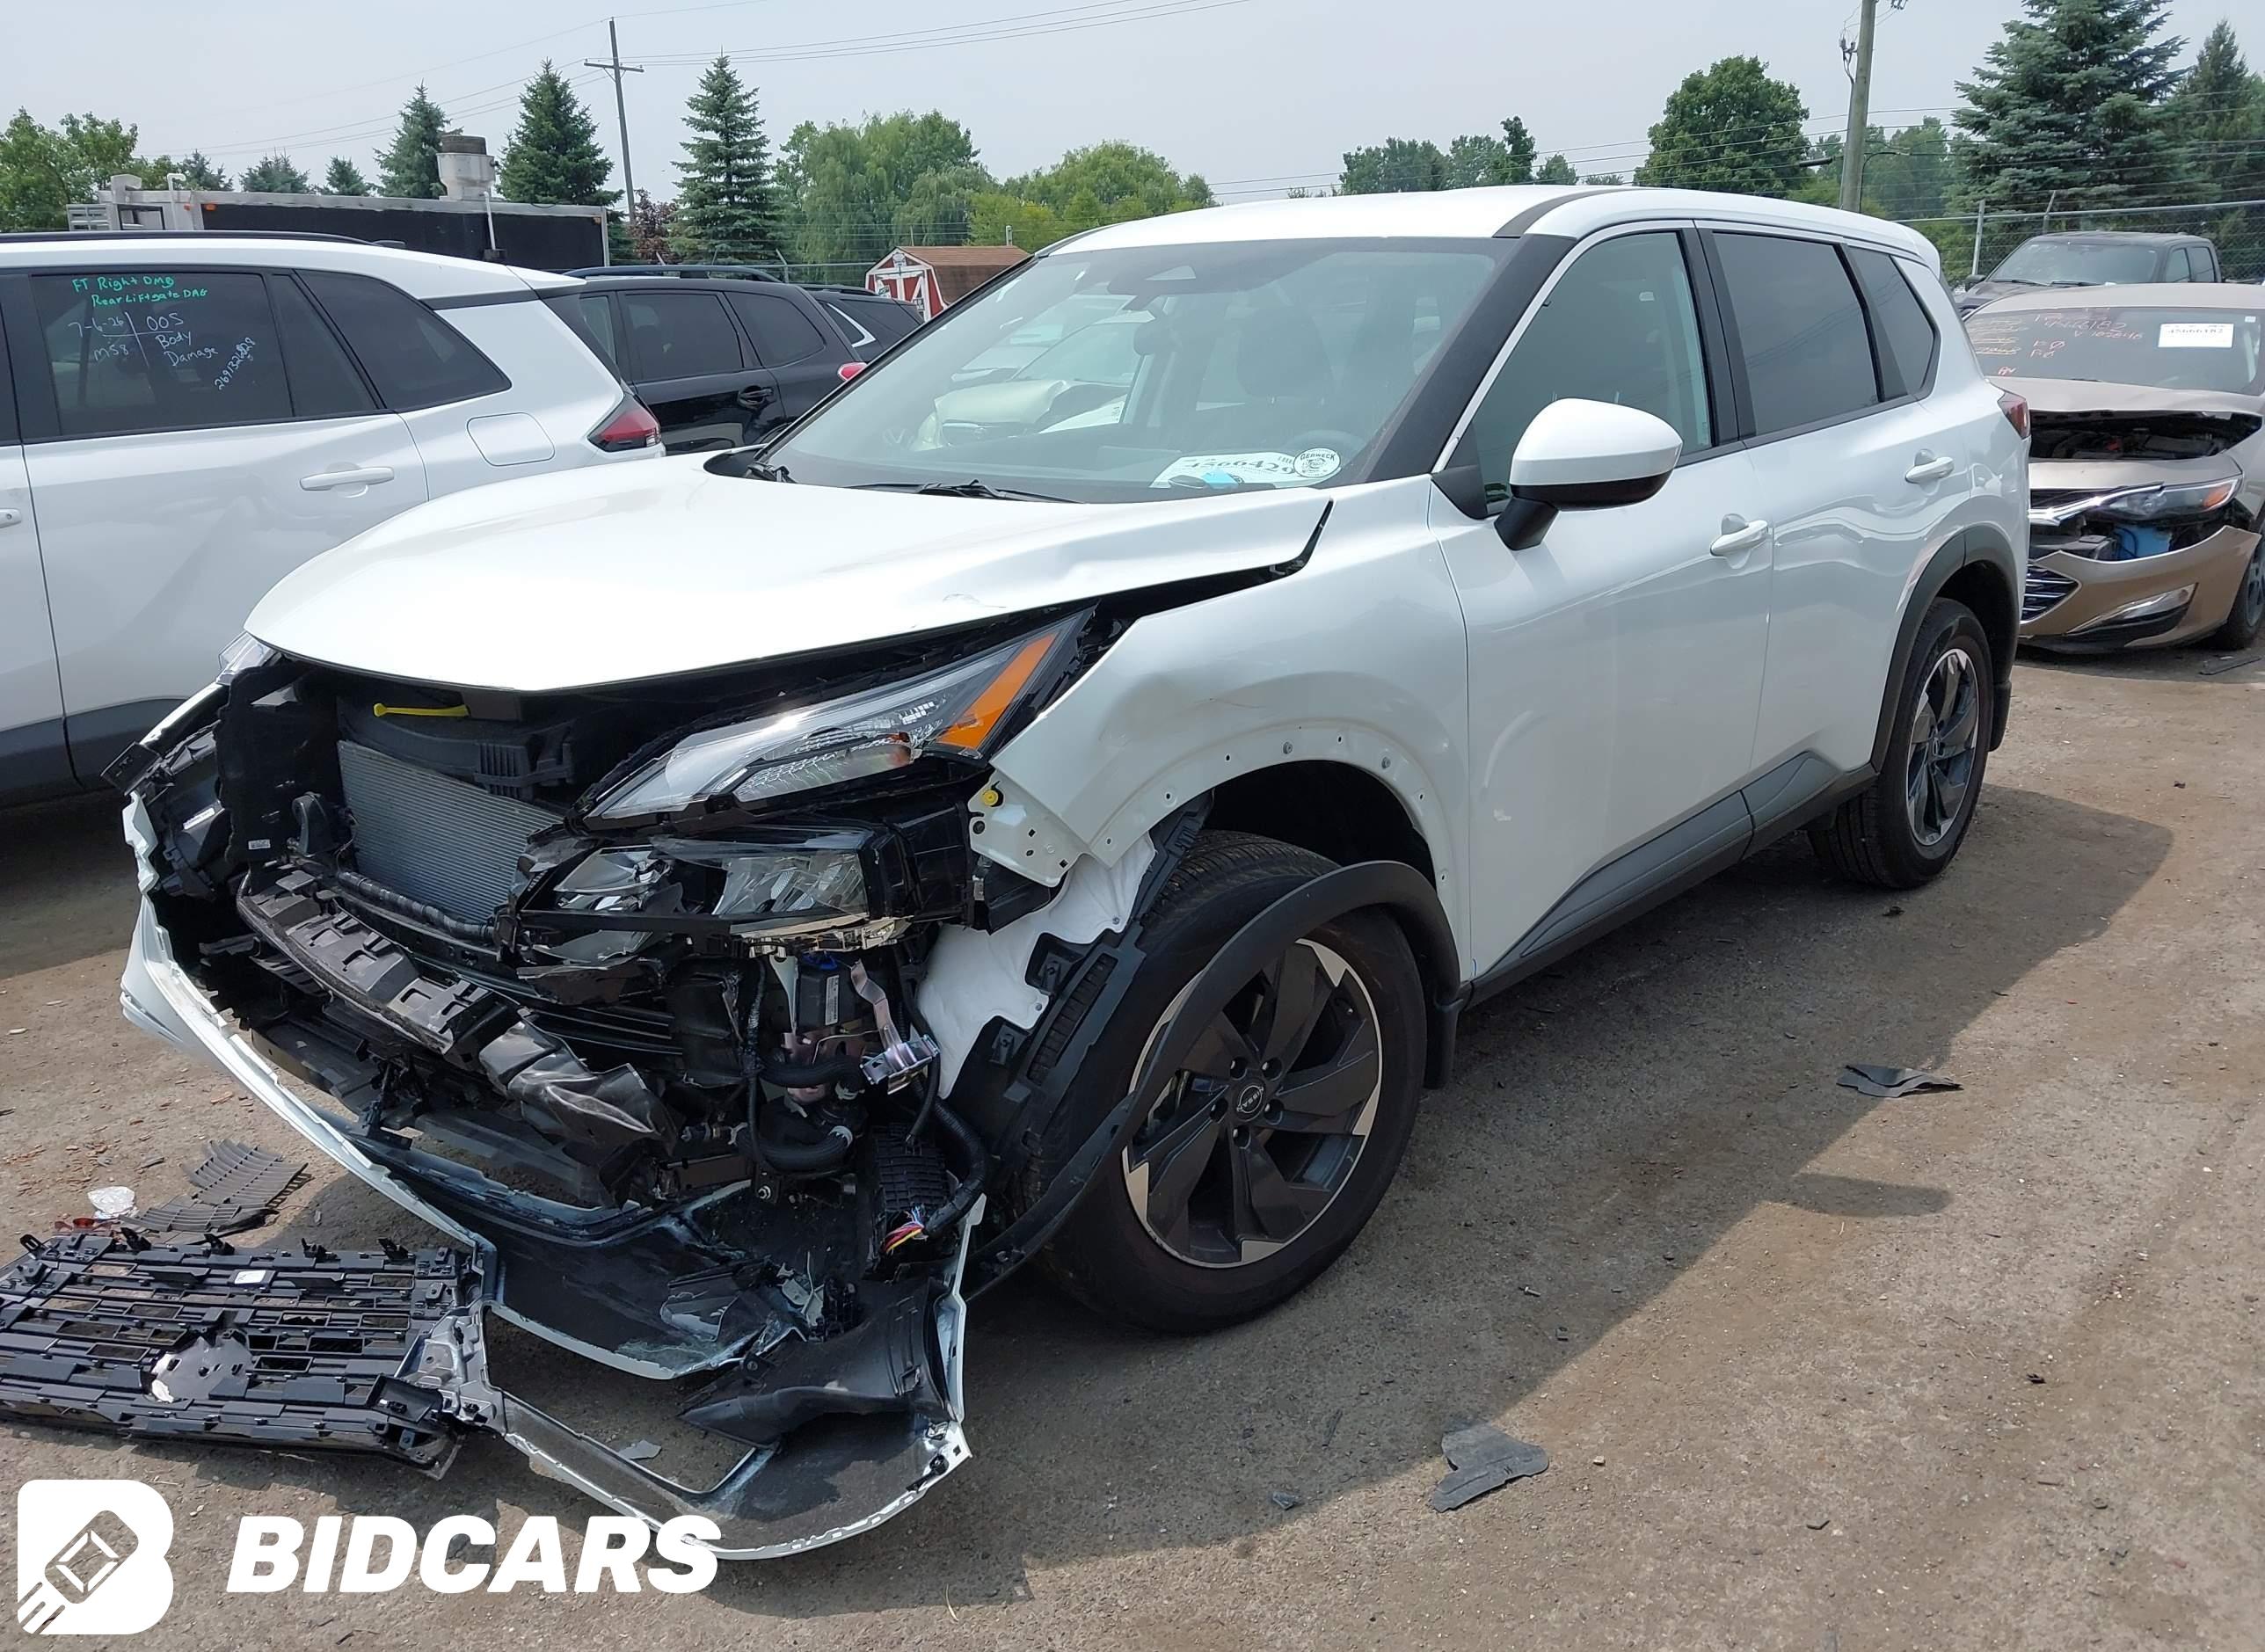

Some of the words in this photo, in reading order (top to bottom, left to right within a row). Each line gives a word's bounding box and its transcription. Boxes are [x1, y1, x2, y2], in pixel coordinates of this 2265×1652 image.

[72, 278, 89, 293] FT
[97, 276, 138, 291] Right
[91, 294, 122, 308] Rear
[155, 331, 192, 350] Body
[163, 347, 219, 367] Damage
